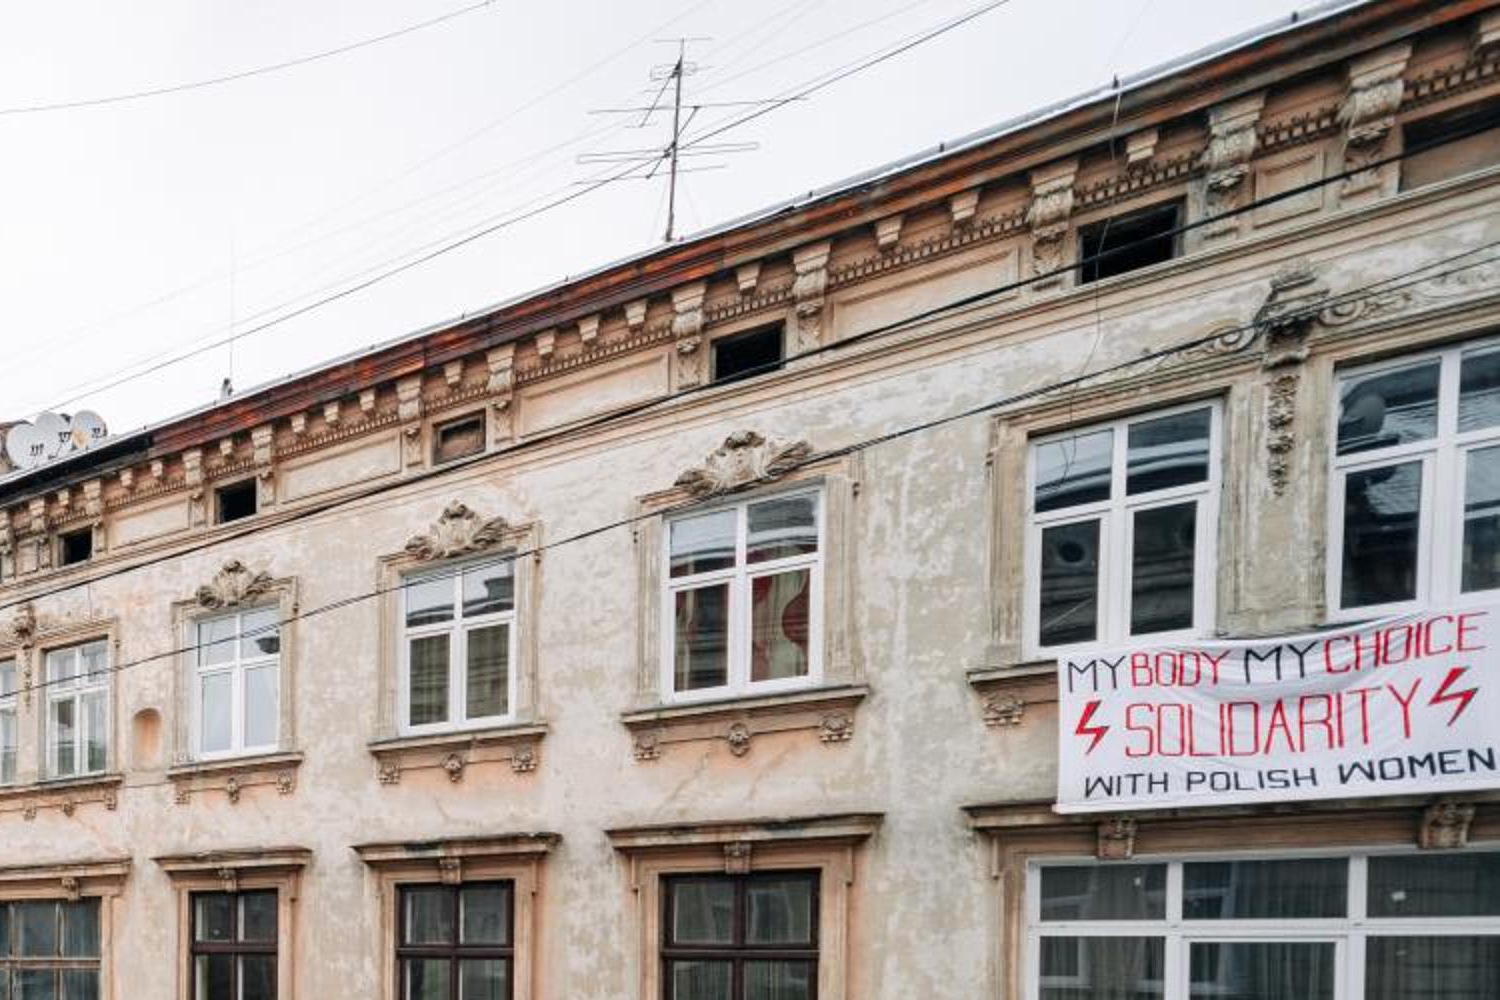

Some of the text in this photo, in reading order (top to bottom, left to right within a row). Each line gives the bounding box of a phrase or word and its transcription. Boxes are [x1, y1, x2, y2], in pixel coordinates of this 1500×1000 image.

[1067, 611, 1490, 694] MY BODY MY CHOICE
[1124, 678, 1422, 758] SOLIDARITY
[1084, 747, 1497, 799] WITH POLISH WOMEN
